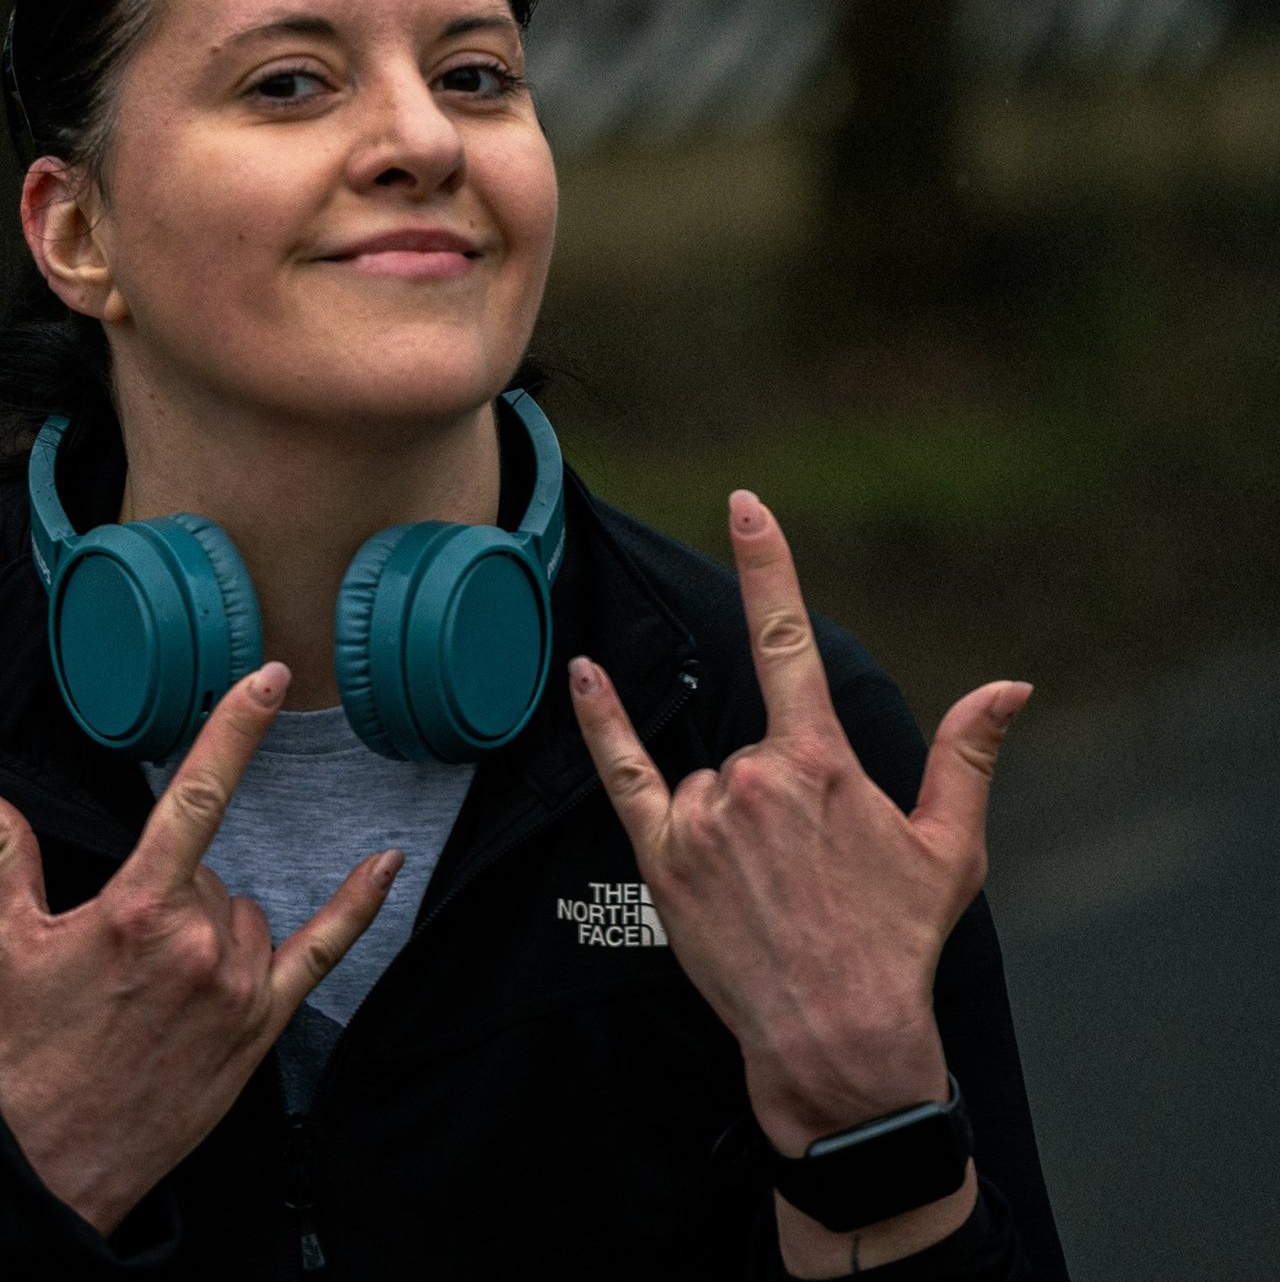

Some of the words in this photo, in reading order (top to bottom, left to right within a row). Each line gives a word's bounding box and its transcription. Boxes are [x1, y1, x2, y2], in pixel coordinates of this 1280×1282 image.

[588, 882, 639, 904] THE
[557, 898, 639, 925] NORTH
[578, 923, 640, 948] FACE
